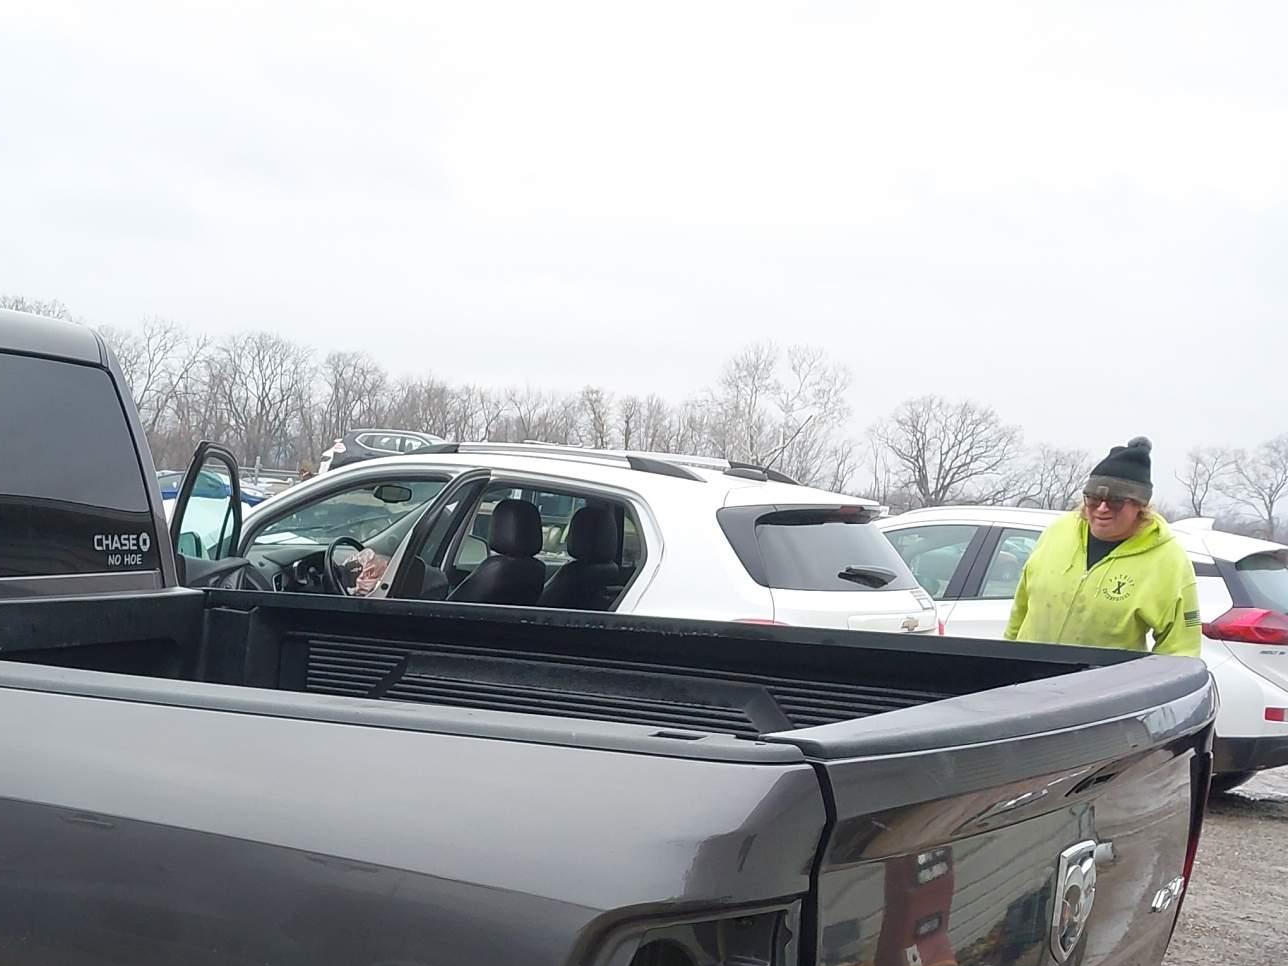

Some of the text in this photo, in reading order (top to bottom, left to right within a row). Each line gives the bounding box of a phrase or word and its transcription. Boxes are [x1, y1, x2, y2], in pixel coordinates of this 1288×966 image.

[93, 534, 138, 550] CHASE
[108, 553, 143, 566] NO HOE
